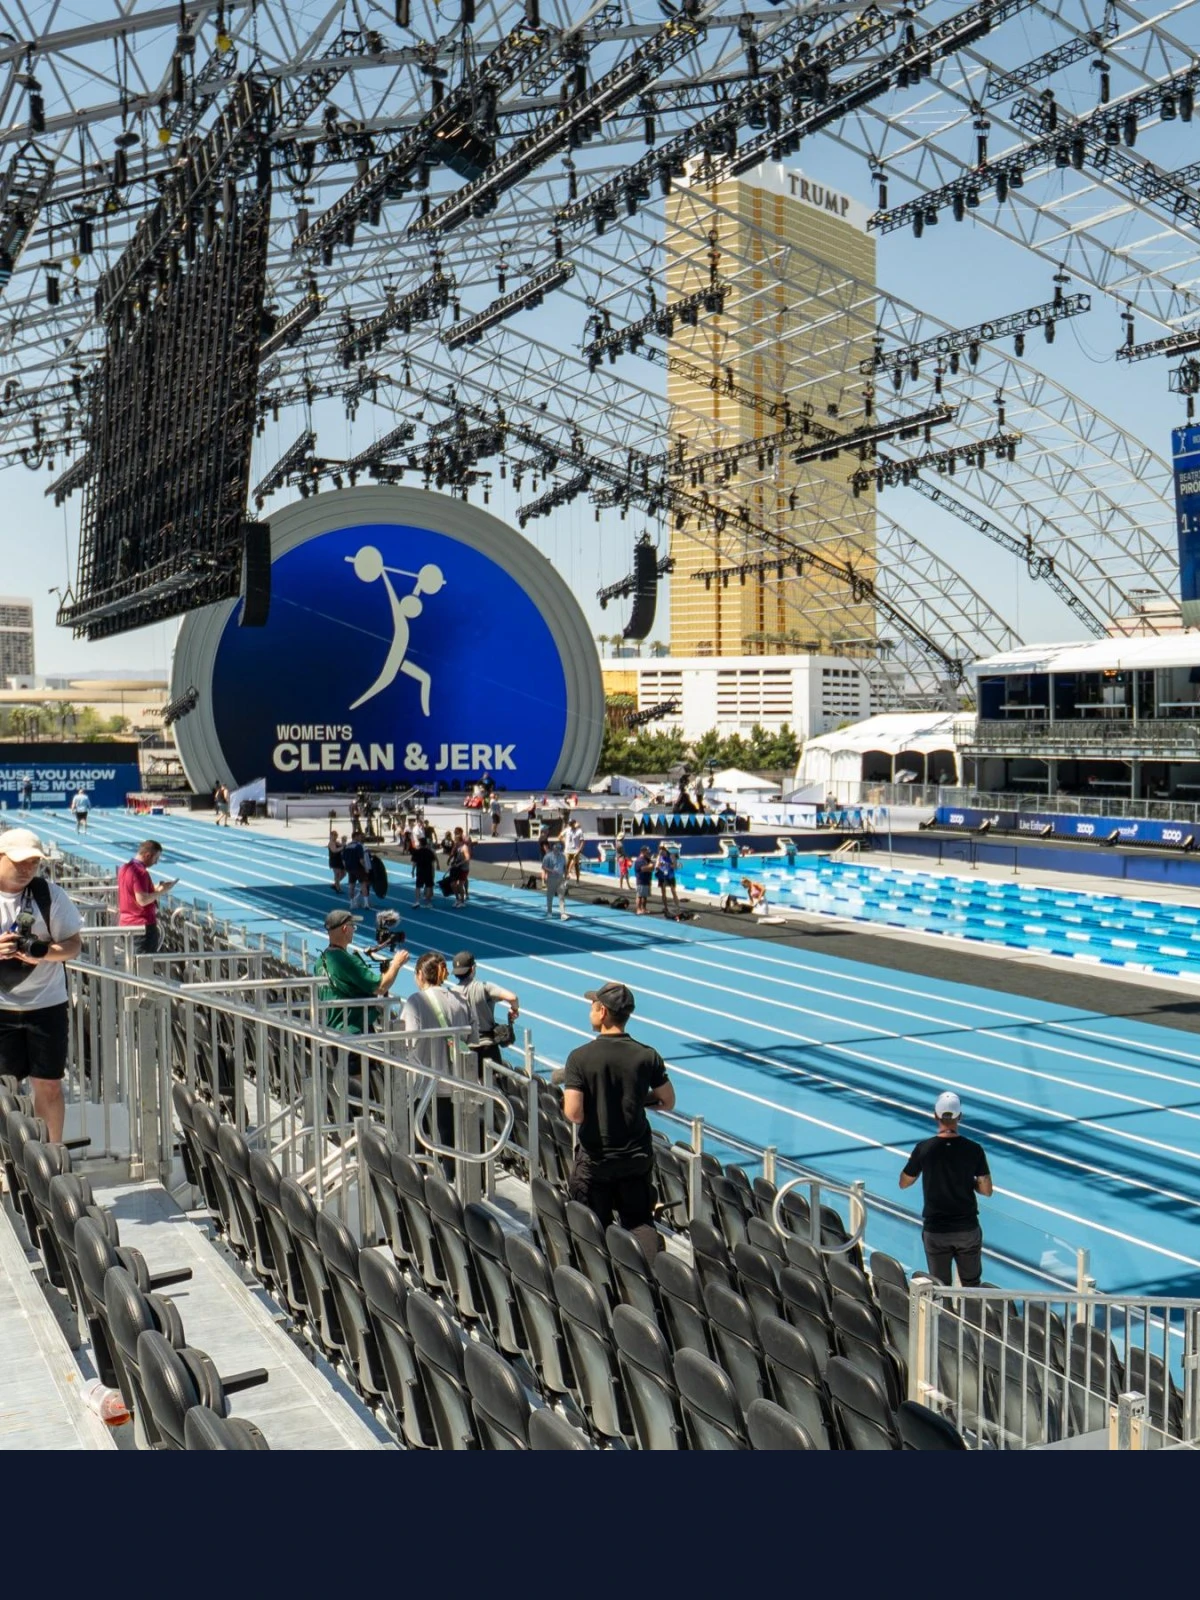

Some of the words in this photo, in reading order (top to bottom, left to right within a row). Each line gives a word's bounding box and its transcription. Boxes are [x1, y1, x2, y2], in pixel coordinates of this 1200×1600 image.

[787, 173, 850, 217] TRUMP
[276, 724, 352, 741] WOMEN'S
[272, 742, 394, 772] CLEAN
[404, 742, 429, 771] &
[435, 743, 517, 771] JERK
[36, 769, 67, 780] YOU
[70, 769, 116, 780] KNOW
[52, 780, 95, 791] MORE
[1077, 823, 1094, 835] zoop
[1162, 829, 1182, 842] zoop
